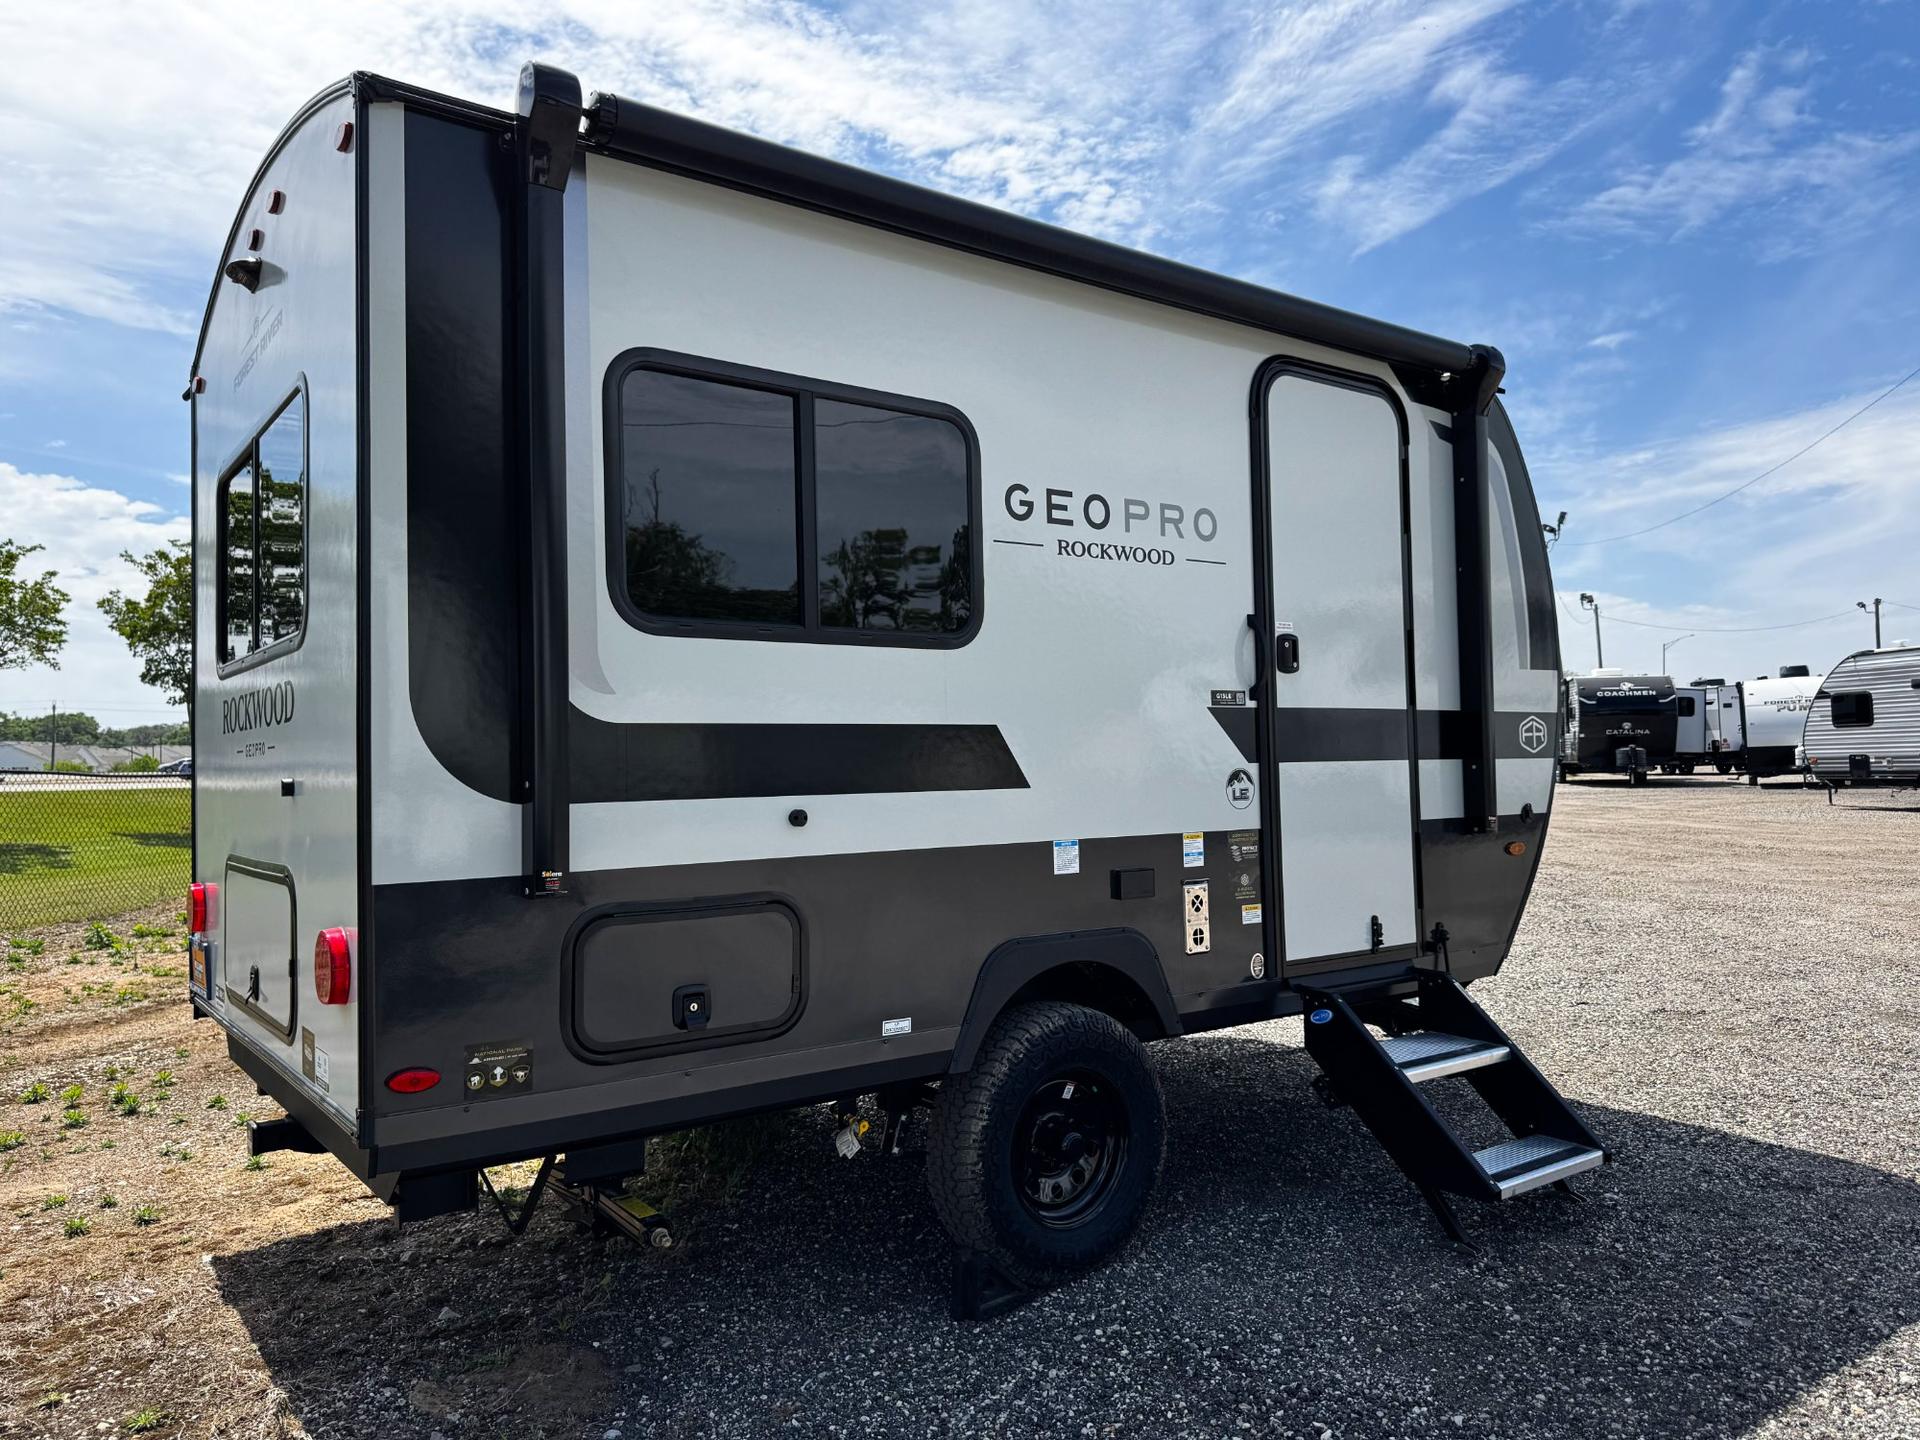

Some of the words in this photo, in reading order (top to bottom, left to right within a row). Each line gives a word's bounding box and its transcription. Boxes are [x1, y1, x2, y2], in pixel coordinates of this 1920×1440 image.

[233, 343, 259, 393] FOREST
[260, 311, 283, 356] RIVER
[1004, 483, 1218, 543] GEOPRO
[1057, 539, 1176, 566] ROCKWOOD
[223, 680, 295, 735] ROCKWOOD
[1232, 788, 1250, 801] LE
